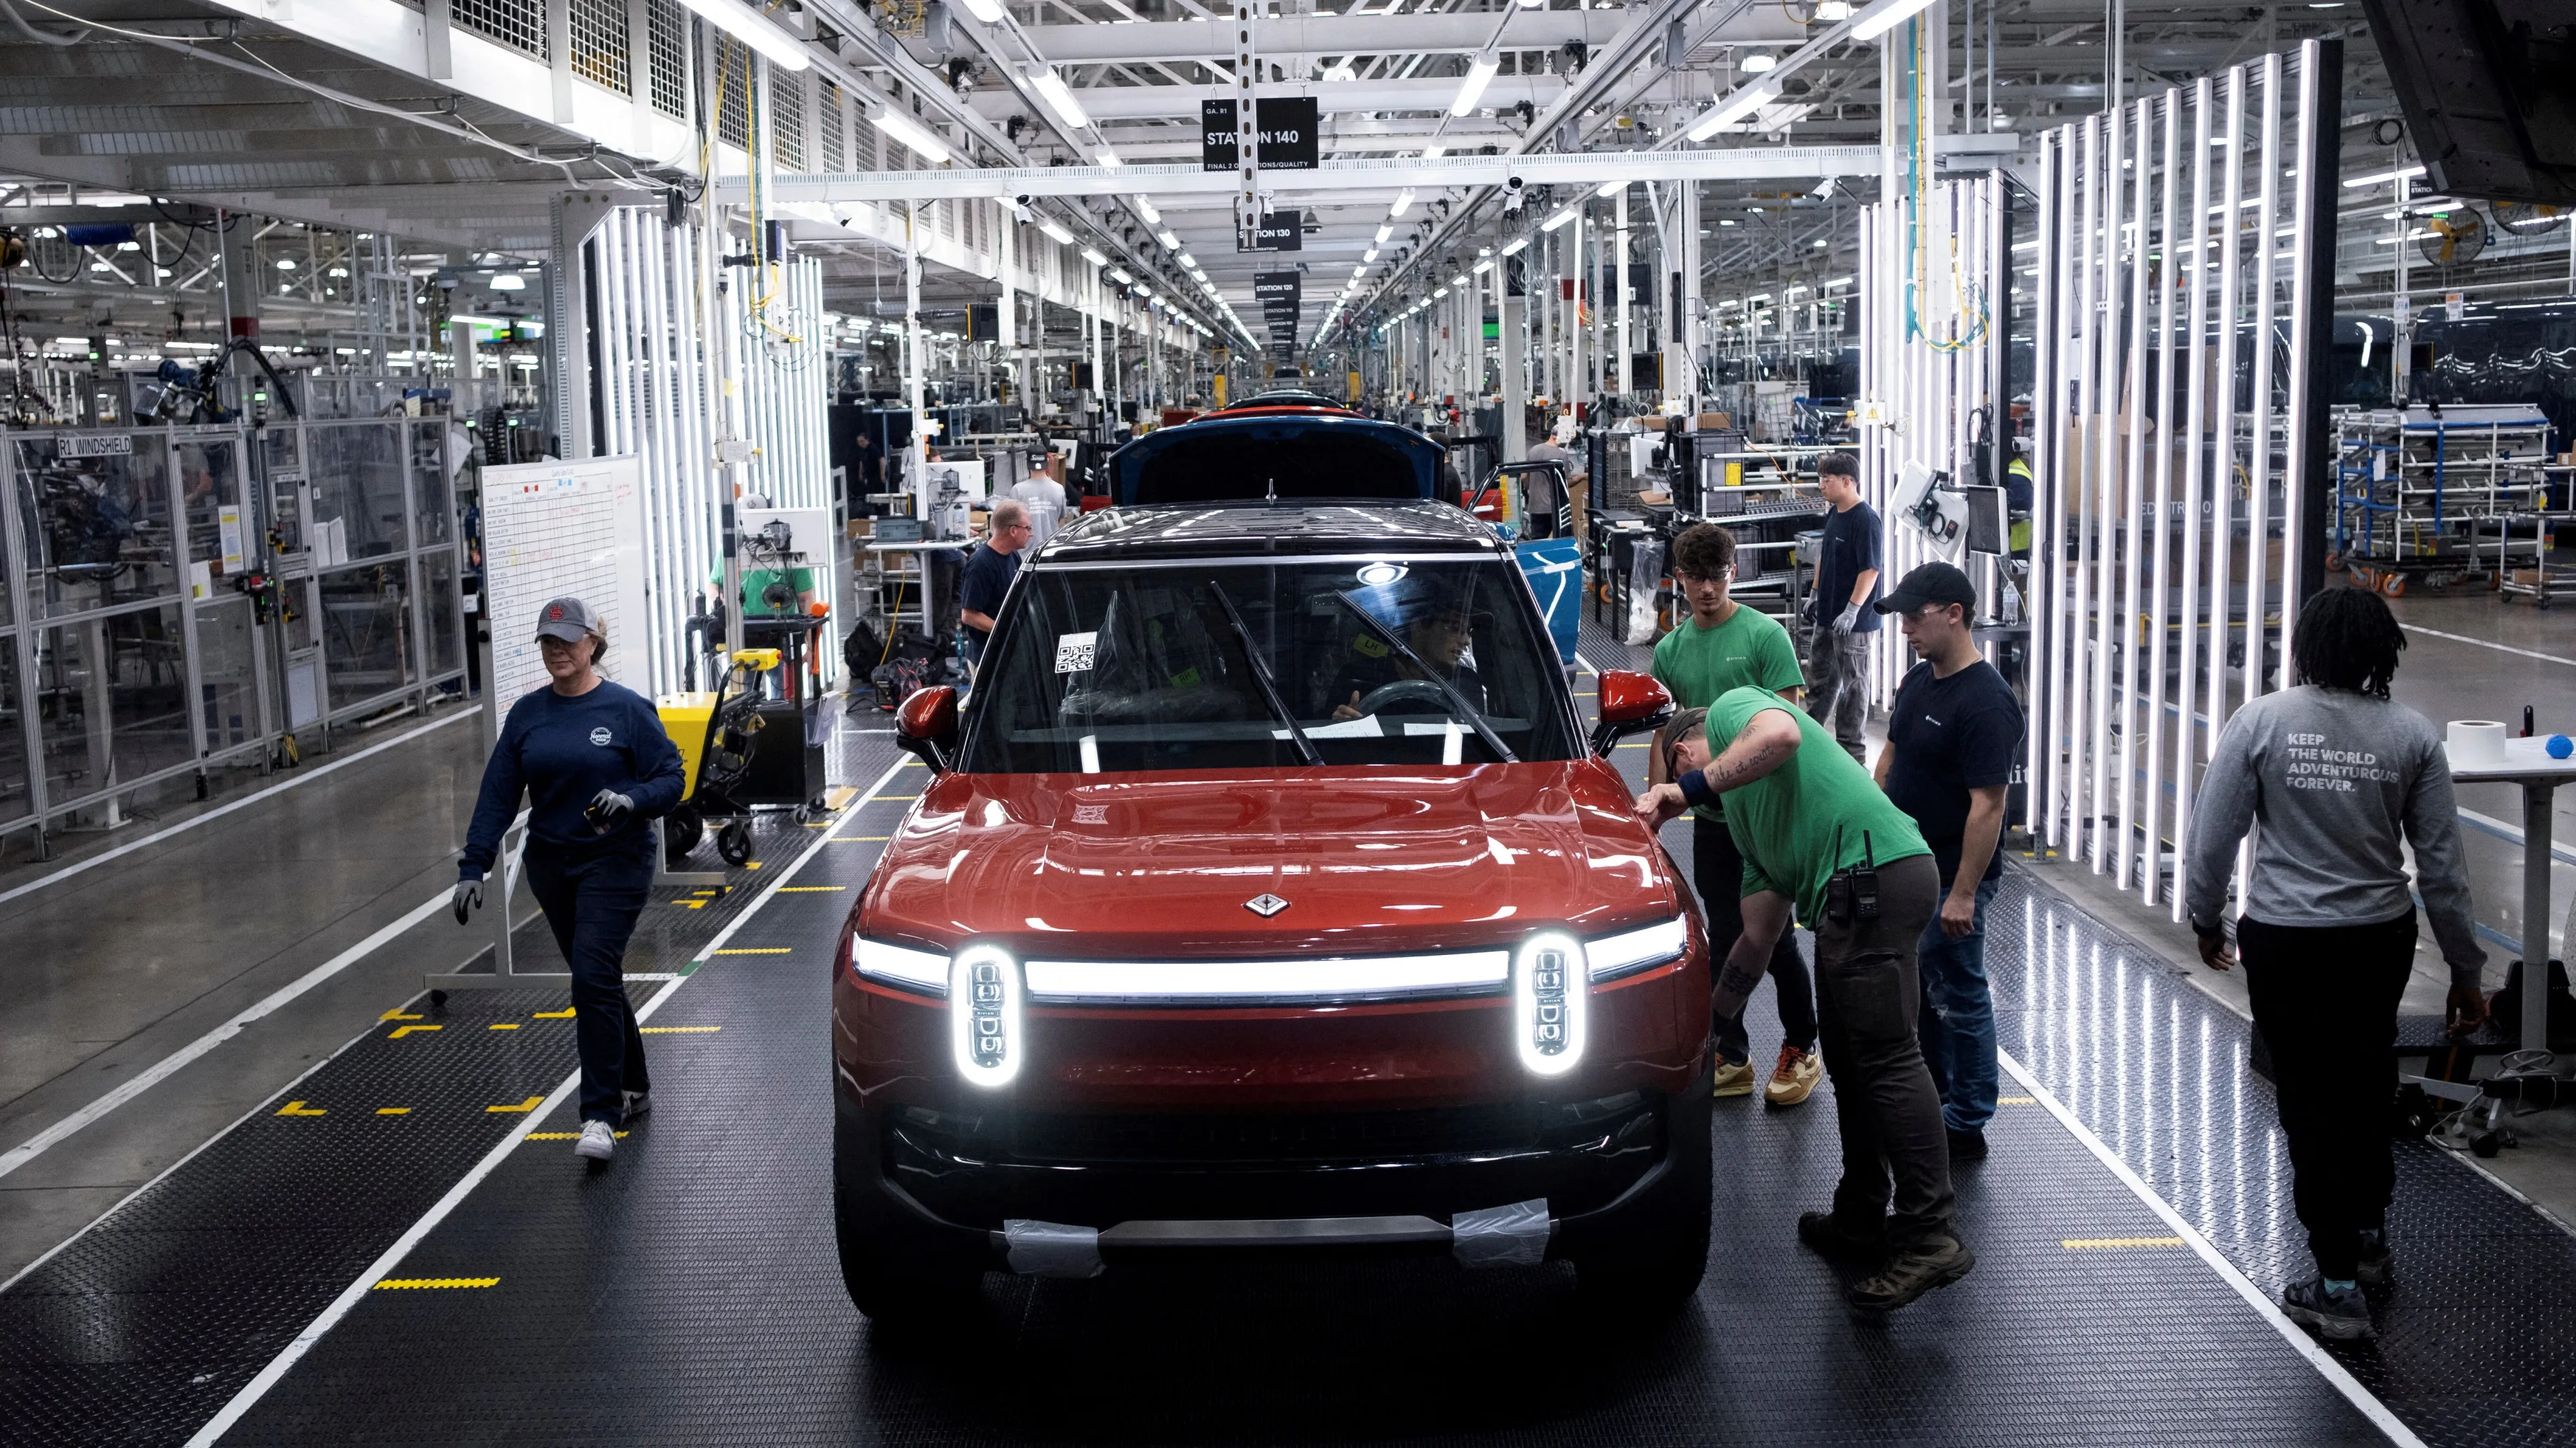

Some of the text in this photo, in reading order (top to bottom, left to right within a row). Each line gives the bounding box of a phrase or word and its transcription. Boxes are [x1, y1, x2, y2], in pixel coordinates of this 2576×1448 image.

[1275, 130, 1299, 144] 140
[1276, 229, 1290, 237] 130
[60, 437, 131, 455] R1 WINDSHIELD
[1364, 639, 1379, 651] LH
[2288, 733, 2325, 746] KEEP
[2288, 748, 2377, 765] THE WORLD
[2287, 762, 2400, 784] ADVENTUROUS
[2286, 777, 2356, 792] FOREVER.
